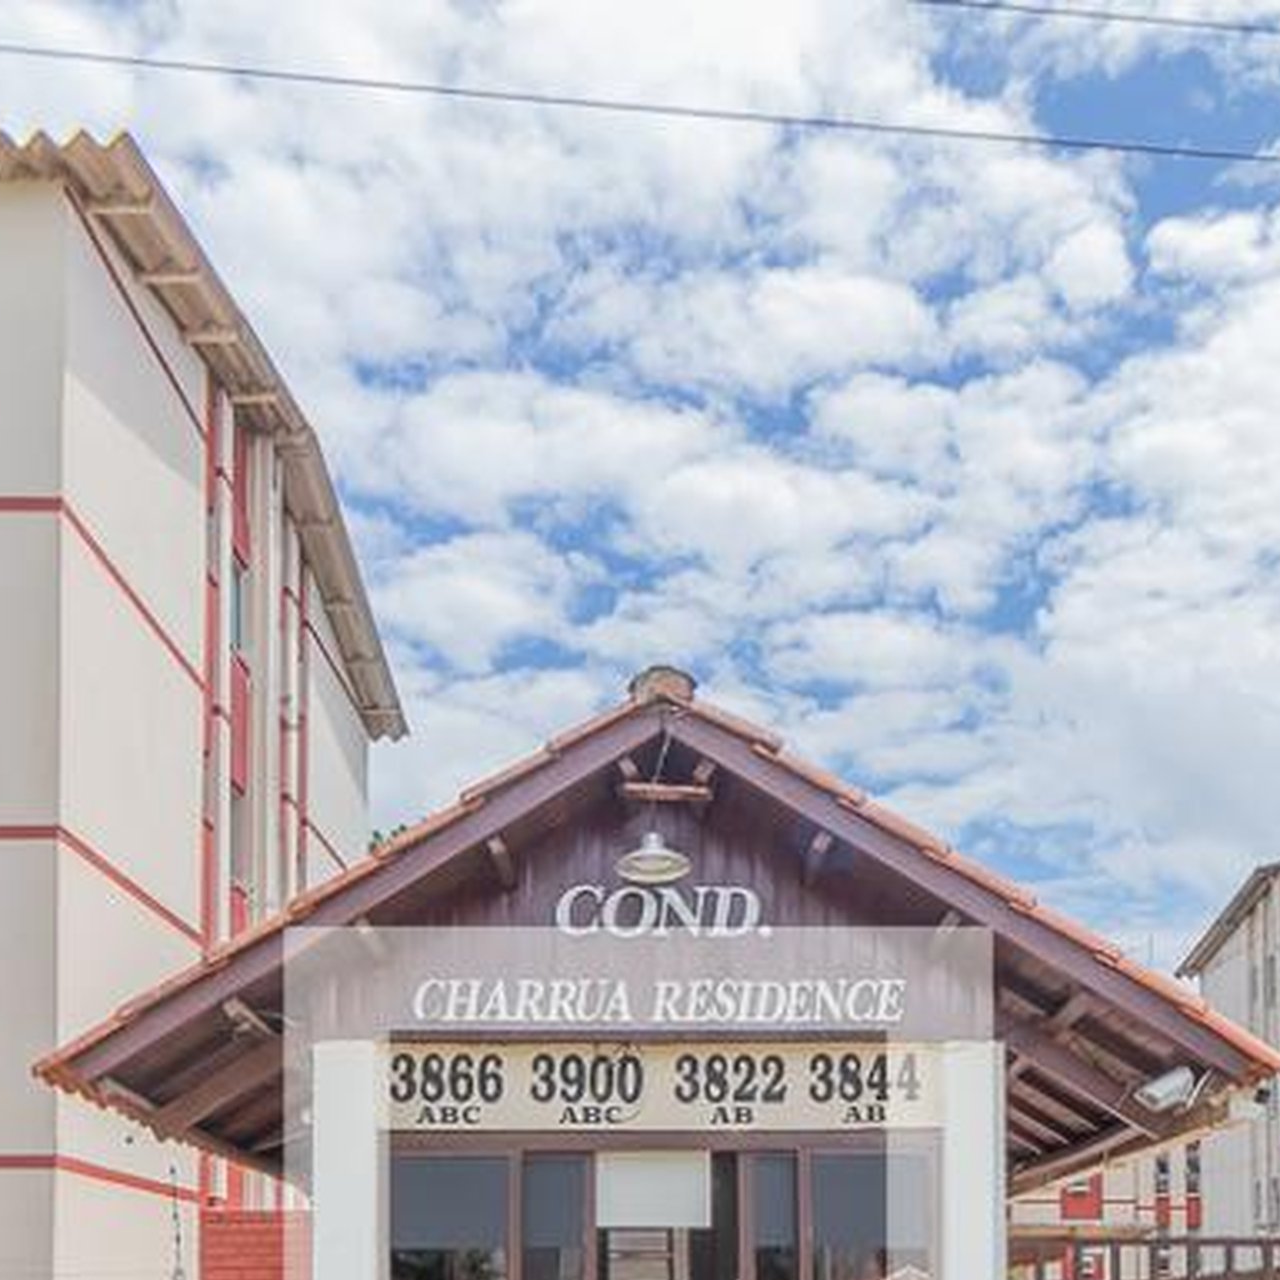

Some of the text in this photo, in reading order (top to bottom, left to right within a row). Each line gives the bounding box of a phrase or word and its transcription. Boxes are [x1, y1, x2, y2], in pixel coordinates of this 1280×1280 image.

[555, 885, 773, 938] COND.
[413, 978, 906, 1023] CHARRUA RESIDENCE
[390, 1053, 920, 1104] 3866 3900 3822 3844
[416, 1106, 481, 1125] ABC
[559, 1106, 622, 1125] ABC
[710, 1106, 753, 1125] AB
